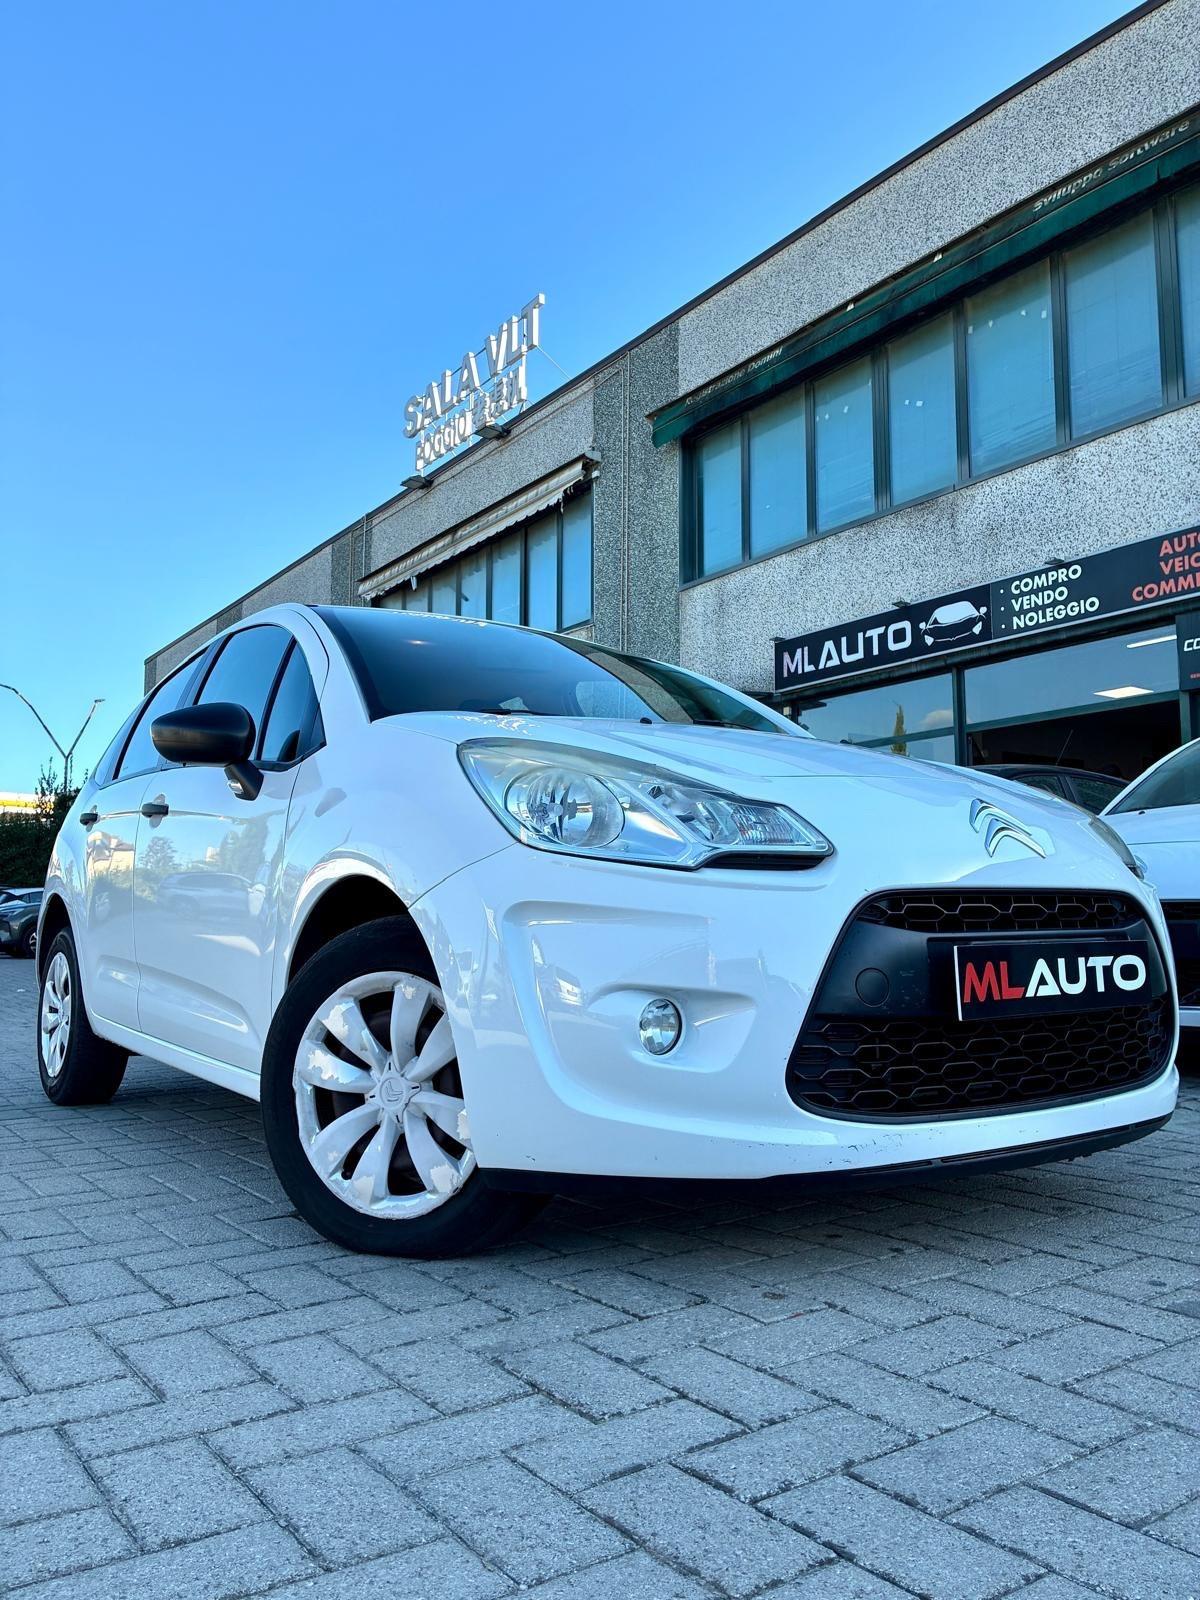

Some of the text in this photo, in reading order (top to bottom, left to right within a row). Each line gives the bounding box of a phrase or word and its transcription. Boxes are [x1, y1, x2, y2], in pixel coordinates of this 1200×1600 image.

[403, 351, 481, 438] SALA
[485, 293, 545, 378] VLT
[1160, 532, 1200, 557] AUT
[1011, 564, 1082, 594] COMPRO
[1011, 586, 1068, 612] VENDO
[1012, 597, 1099, 629] NOLEGGIO
